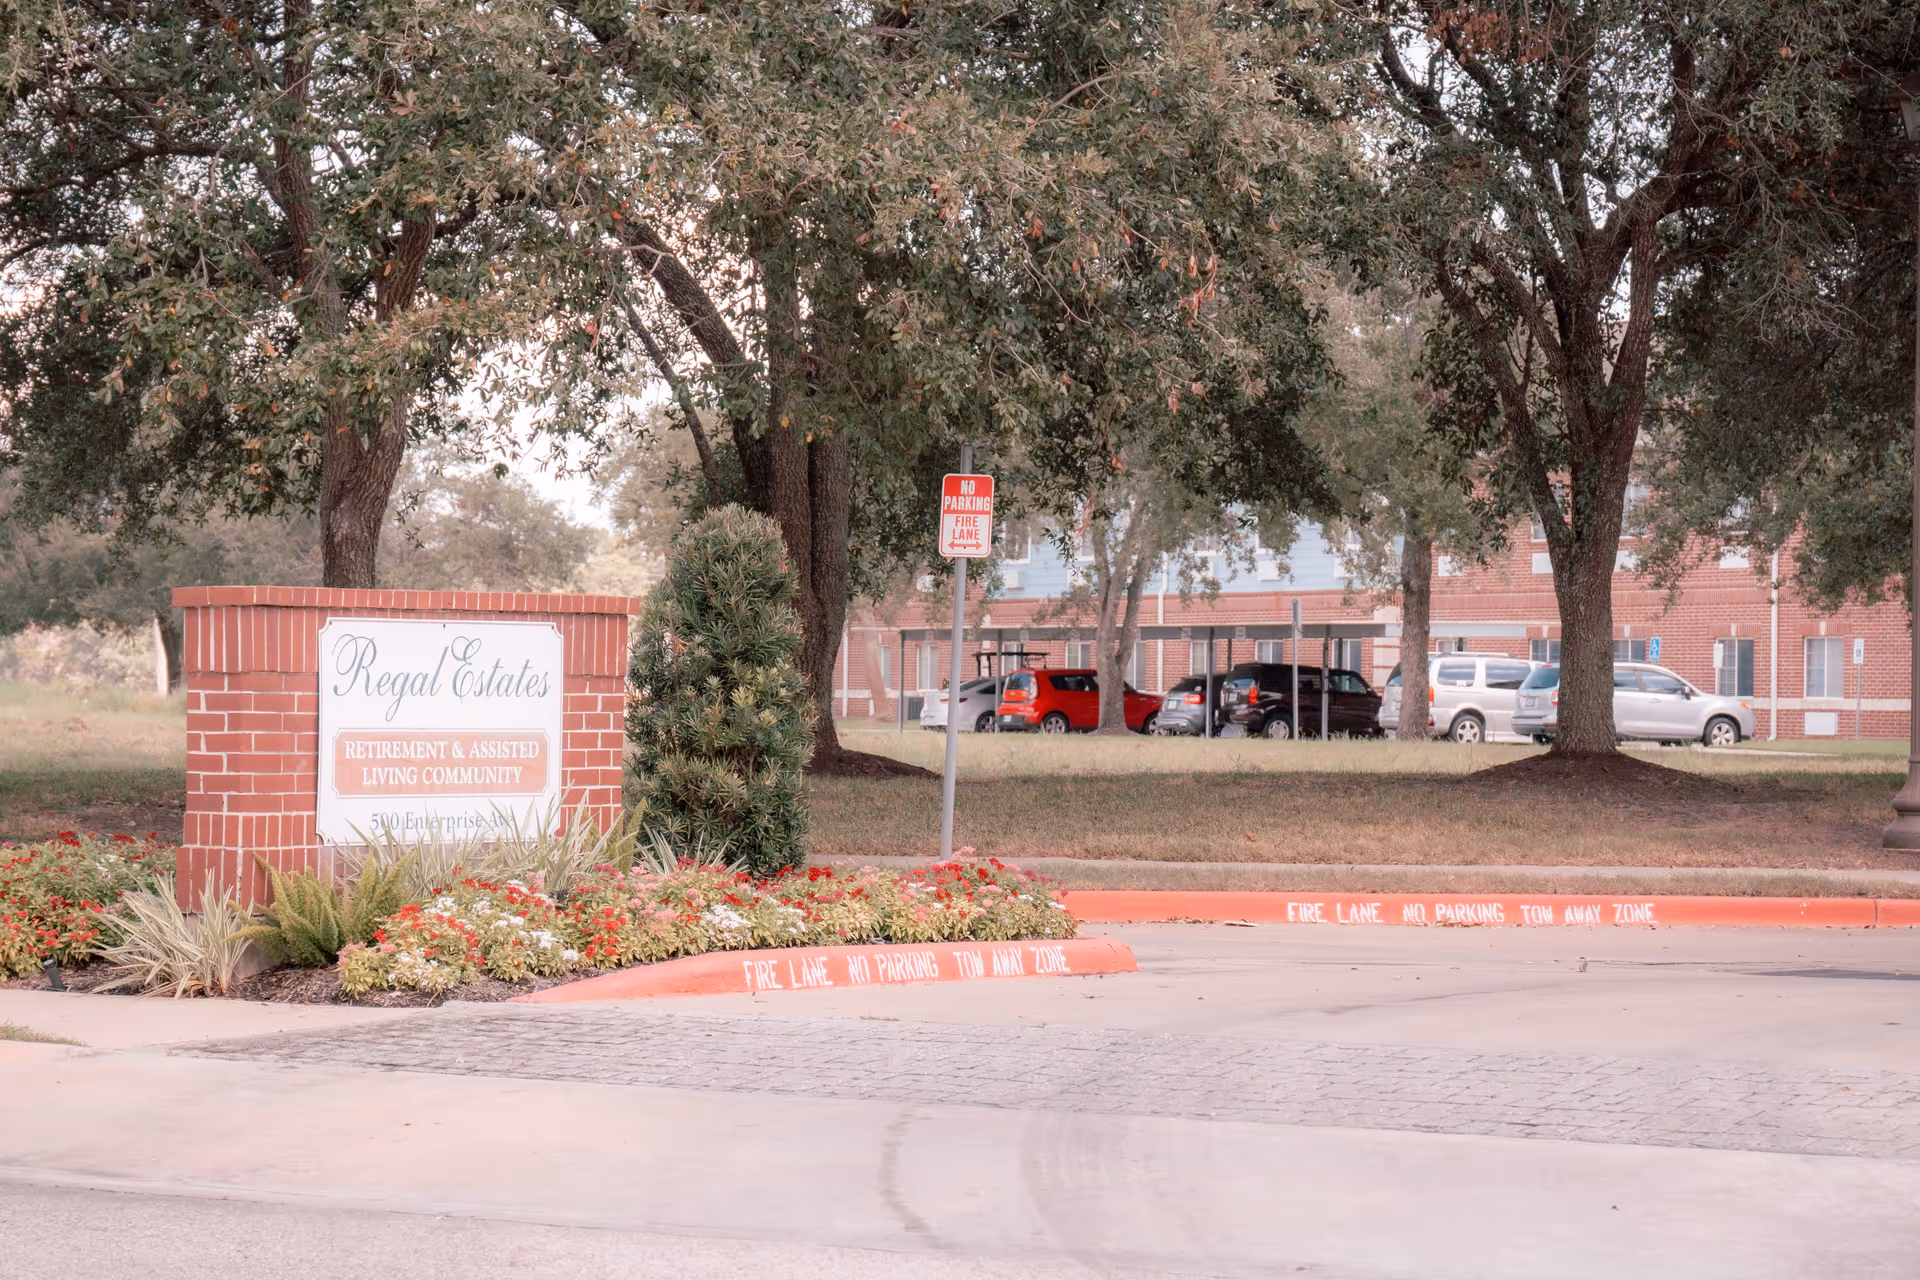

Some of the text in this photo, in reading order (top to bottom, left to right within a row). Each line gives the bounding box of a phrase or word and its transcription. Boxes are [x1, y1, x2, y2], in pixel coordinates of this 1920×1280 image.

[960, 480, 976, 495] NO
[944, 496, 991, 511] PARKING
[955, 515, 979, 528] FIRE
[952, 528, 980, 540] LANE
[332, 633, 551, 722] Regal Estates
[344, 740, 540, 760] RETIREMENT & ASSISTED
[362, 766, 523, 785] LIVING COMMUNITY
[370, 811, 400, 830] 500
[405, 811, 483, 834] Enterprise
[1287, 902, 1658, 924] FIRE LANE NO PARKING TOW AWAY ZONE
[743, 945, 1071, 989] FIRE LANE NO PARKING TOW AWAY ZONE
